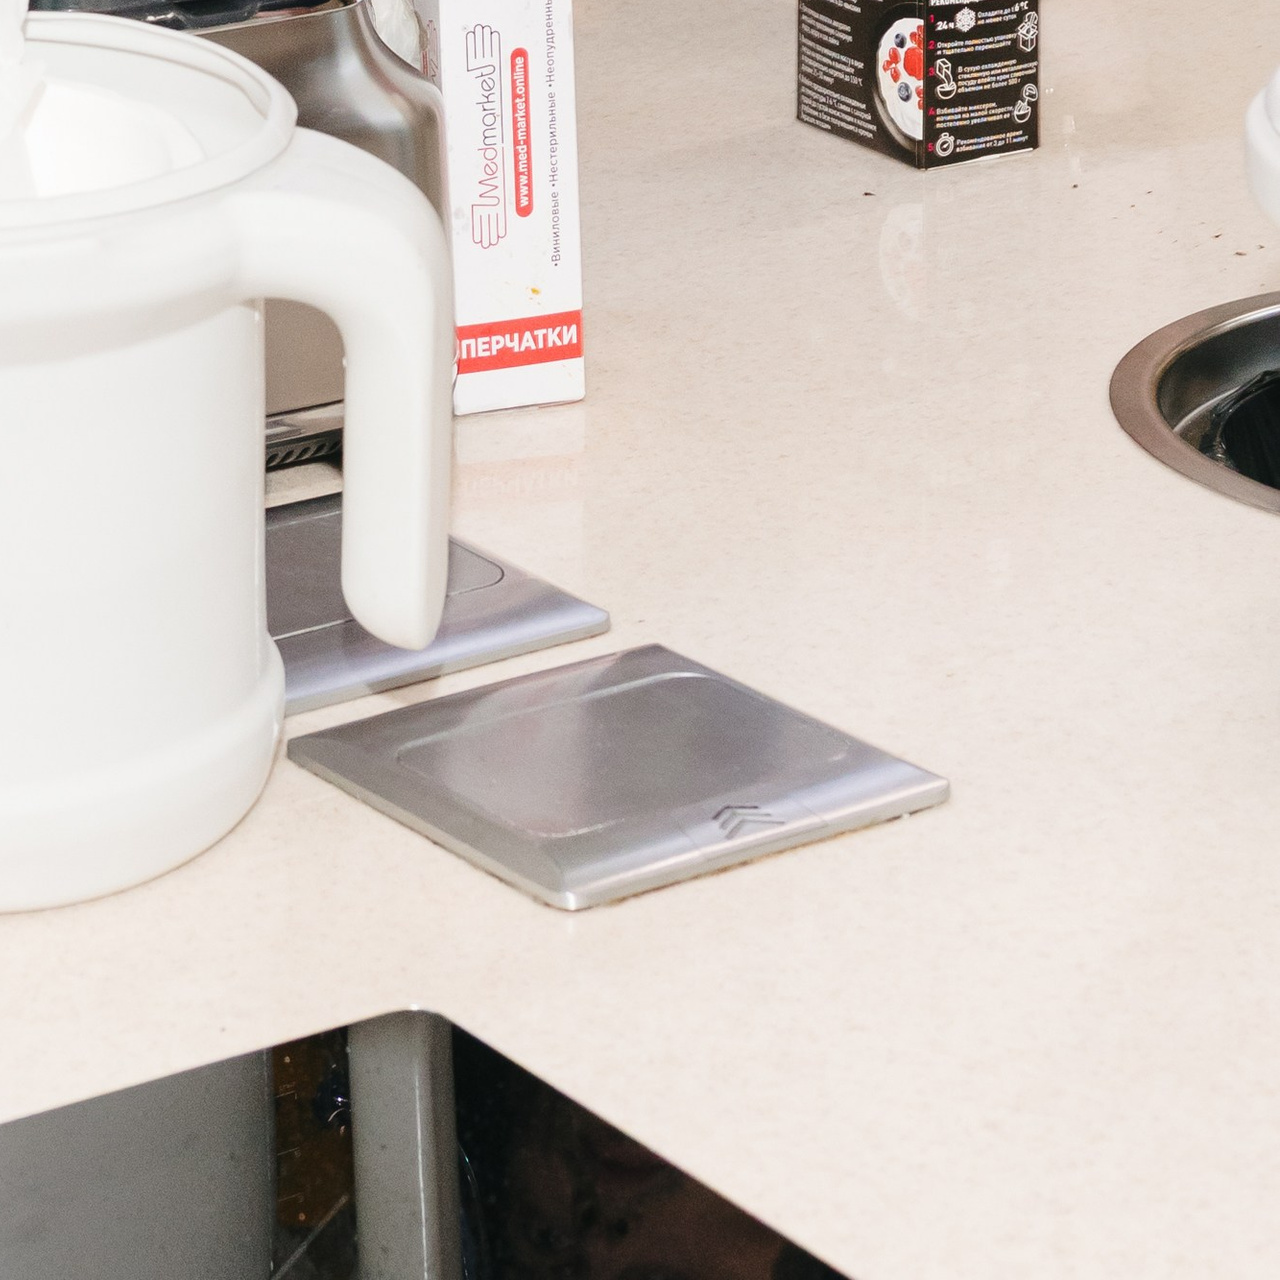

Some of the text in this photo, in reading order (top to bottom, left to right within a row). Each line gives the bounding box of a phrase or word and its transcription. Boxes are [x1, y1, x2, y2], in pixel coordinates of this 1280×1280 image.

[928, 40, 936, 50] 2
[514, 56, 529, 208] www.med-market.online
[461, 324, 578, 359] ПЕРЧАТКИ
